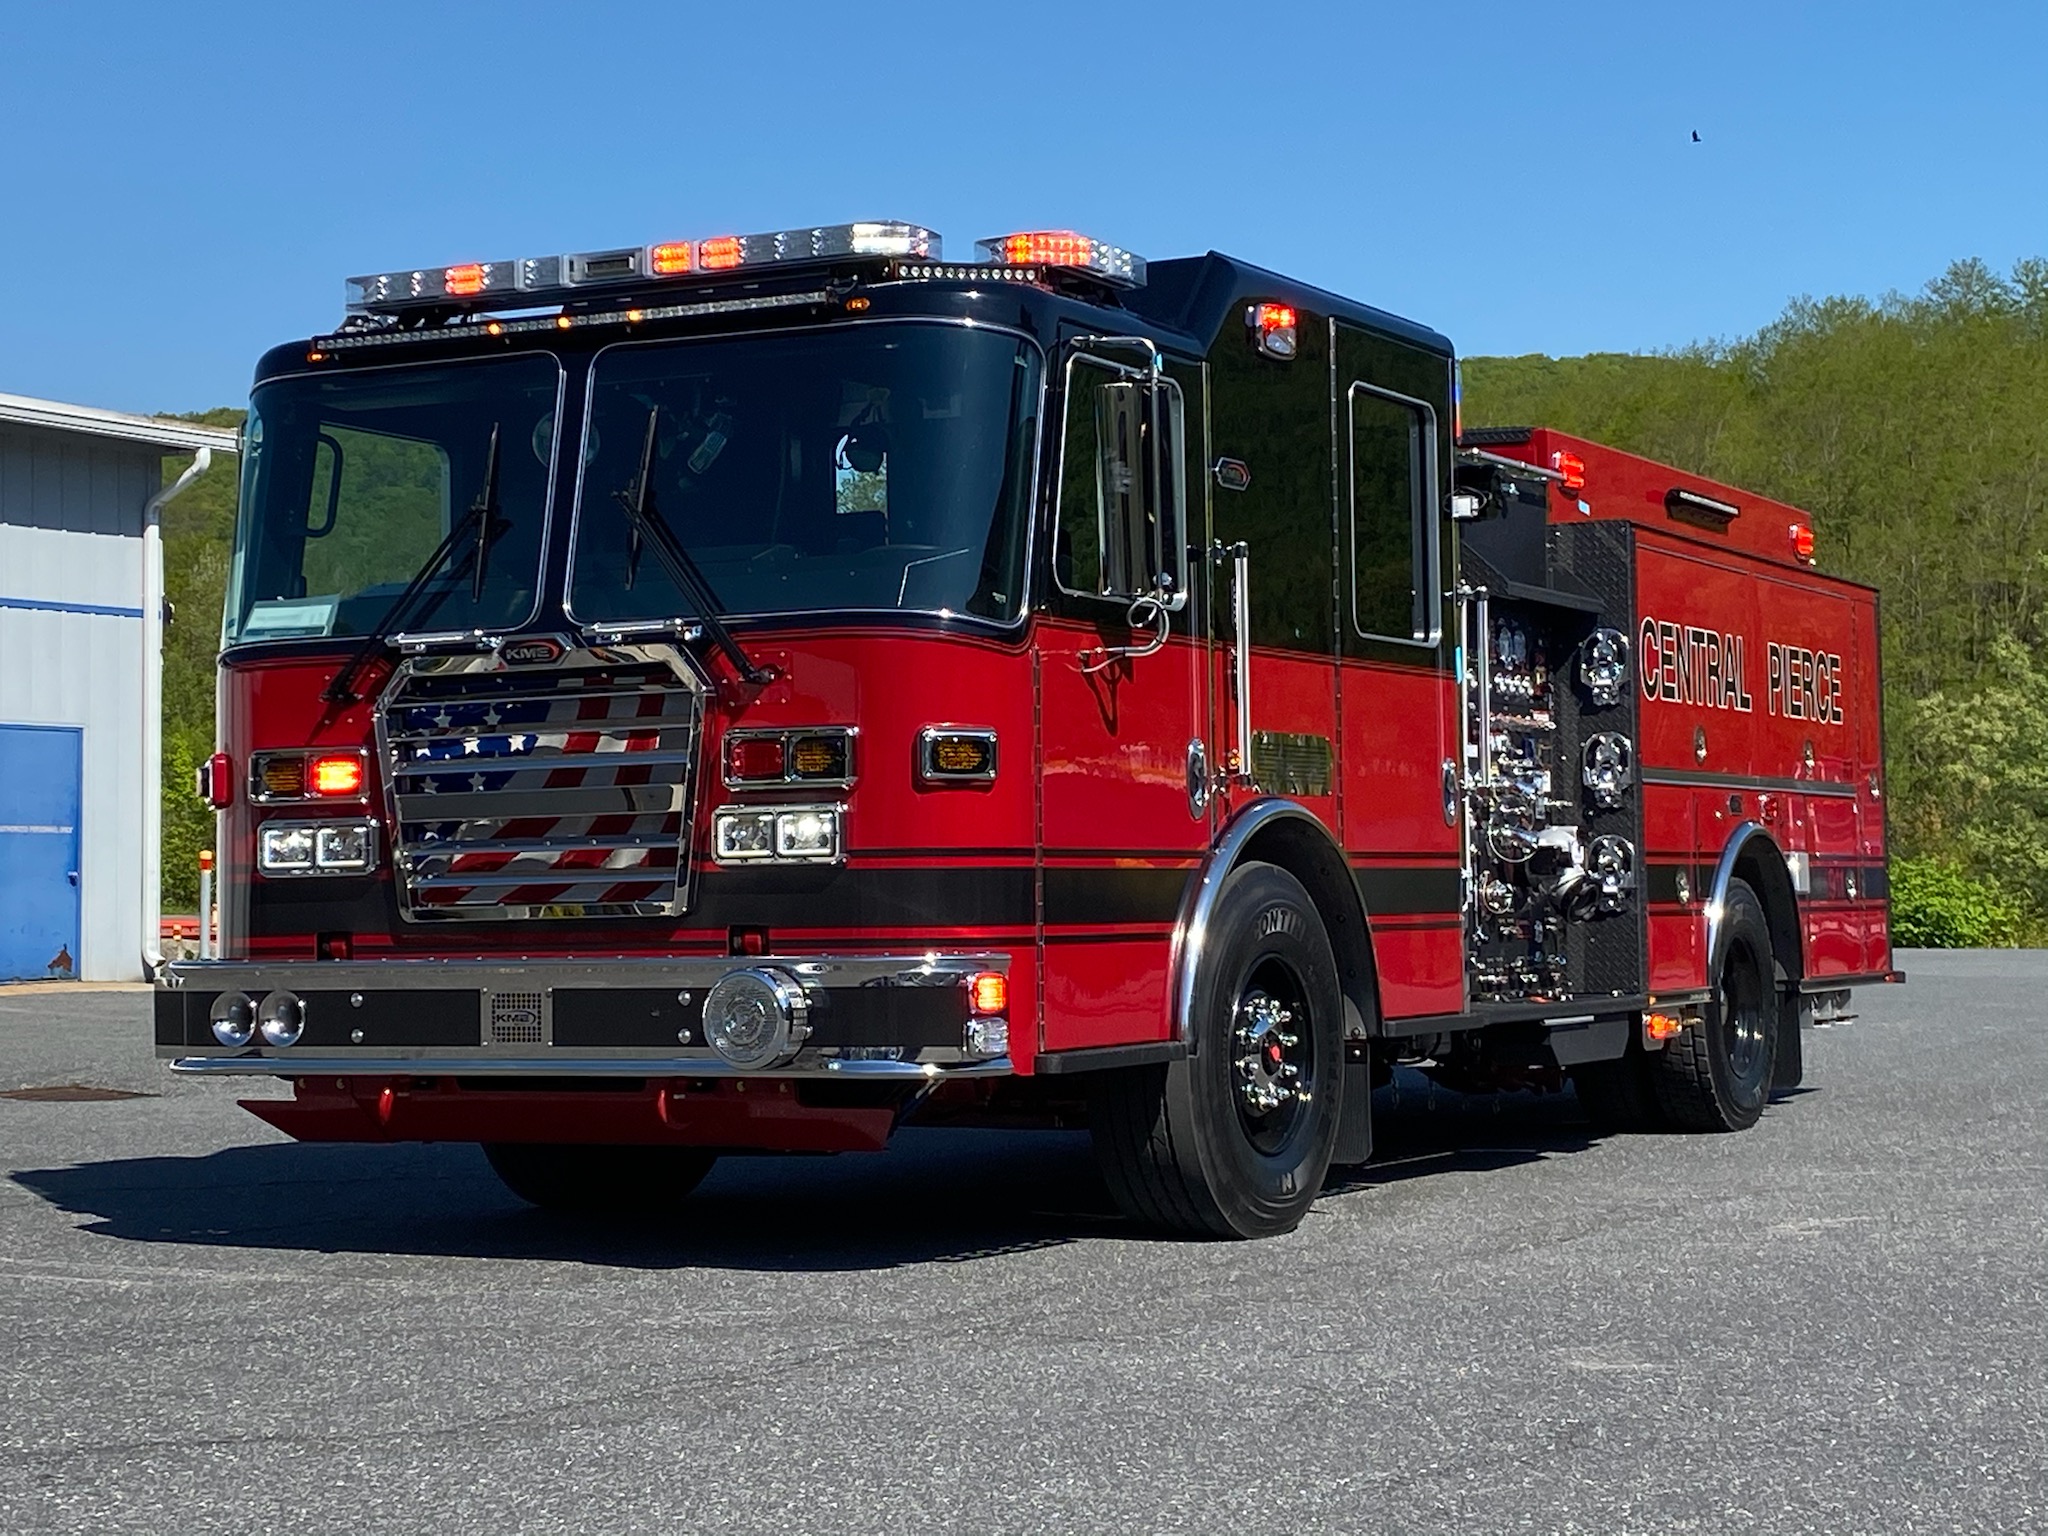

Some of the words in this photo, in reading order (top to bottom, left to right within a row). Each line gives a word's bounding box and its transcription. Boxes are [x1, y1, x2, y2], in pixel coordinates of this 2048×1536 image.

[506, 647, 549, 660] KME
[1640, 616, 1752, 712] CENTRAL
[1767, 642, 1843, 725] PIERCE
